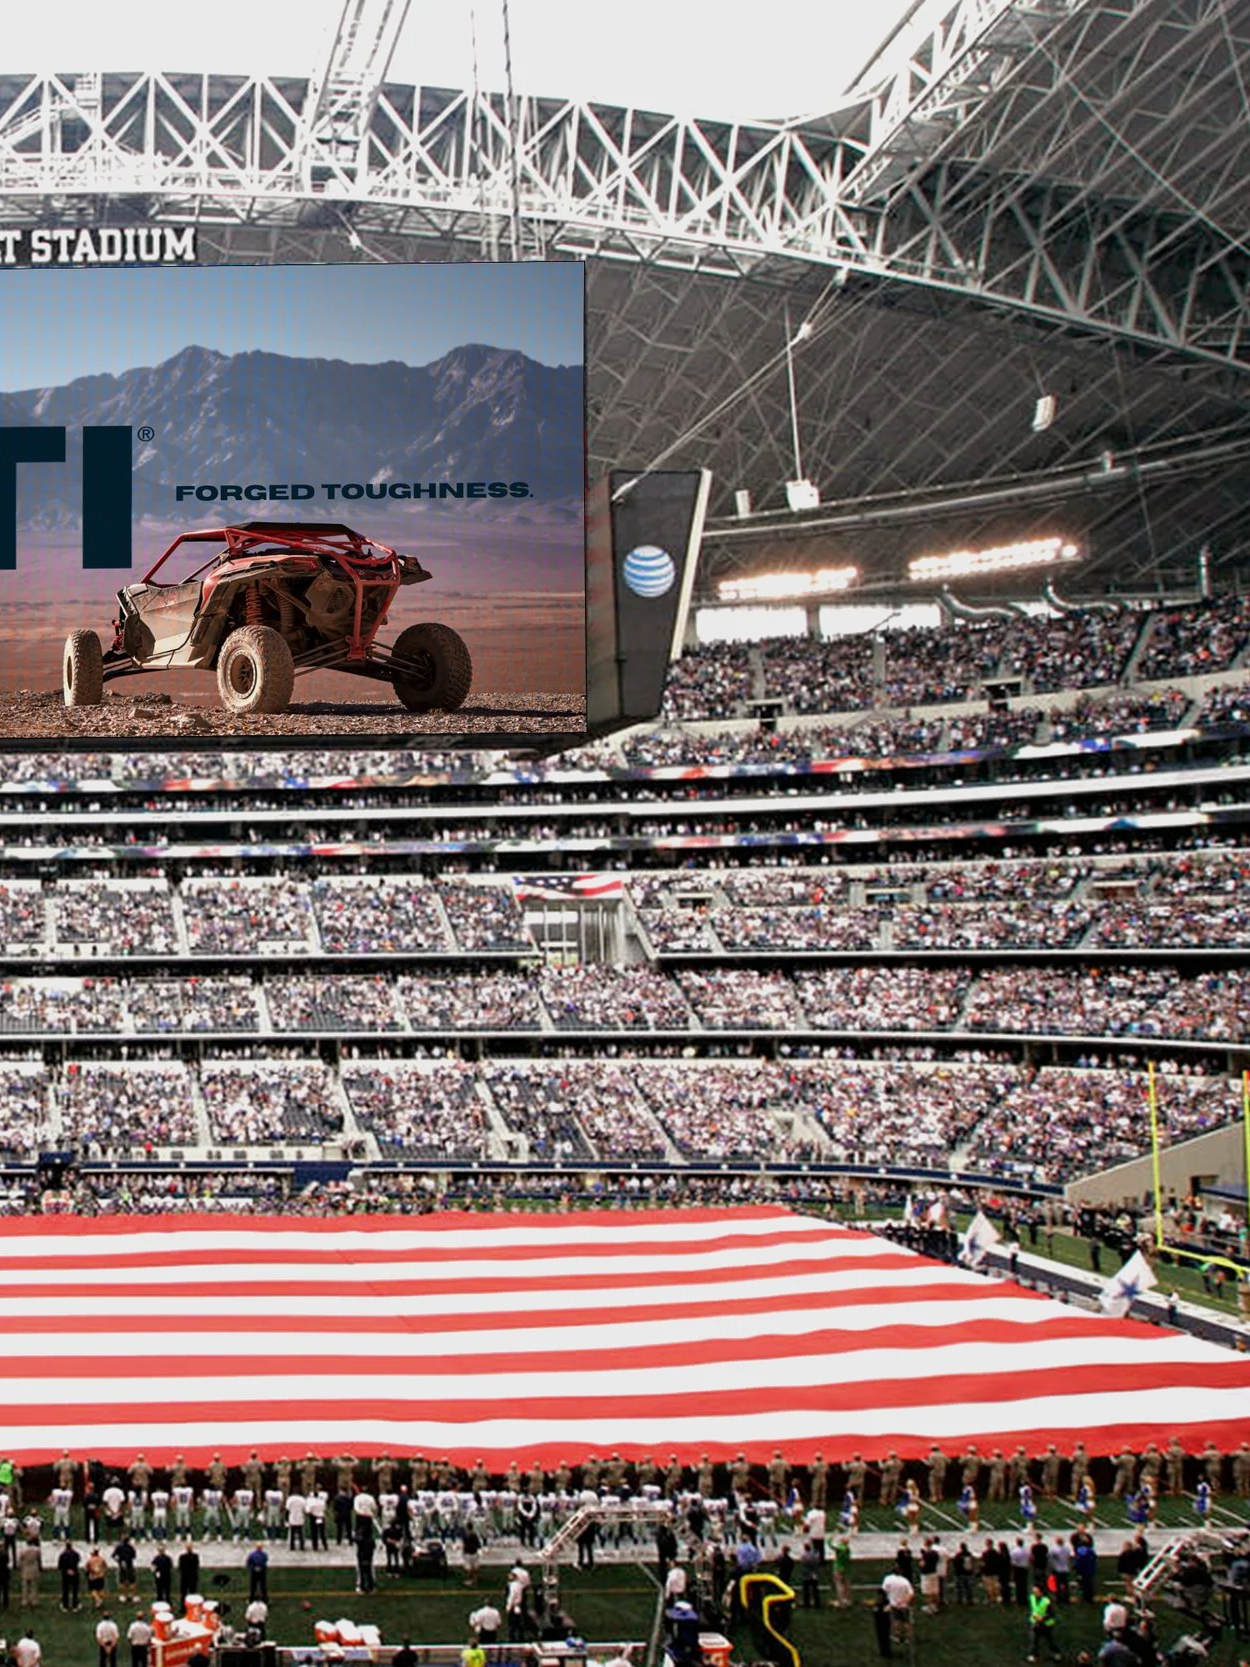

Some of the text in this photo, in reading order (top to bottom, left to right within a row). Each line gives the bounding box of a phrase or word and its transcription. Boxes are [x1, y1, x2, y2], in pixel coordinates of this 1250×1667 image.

[30, 228, 196, 263] STADIUM
[175, 481, 535, 502] FORGED TOUGHNESS.
